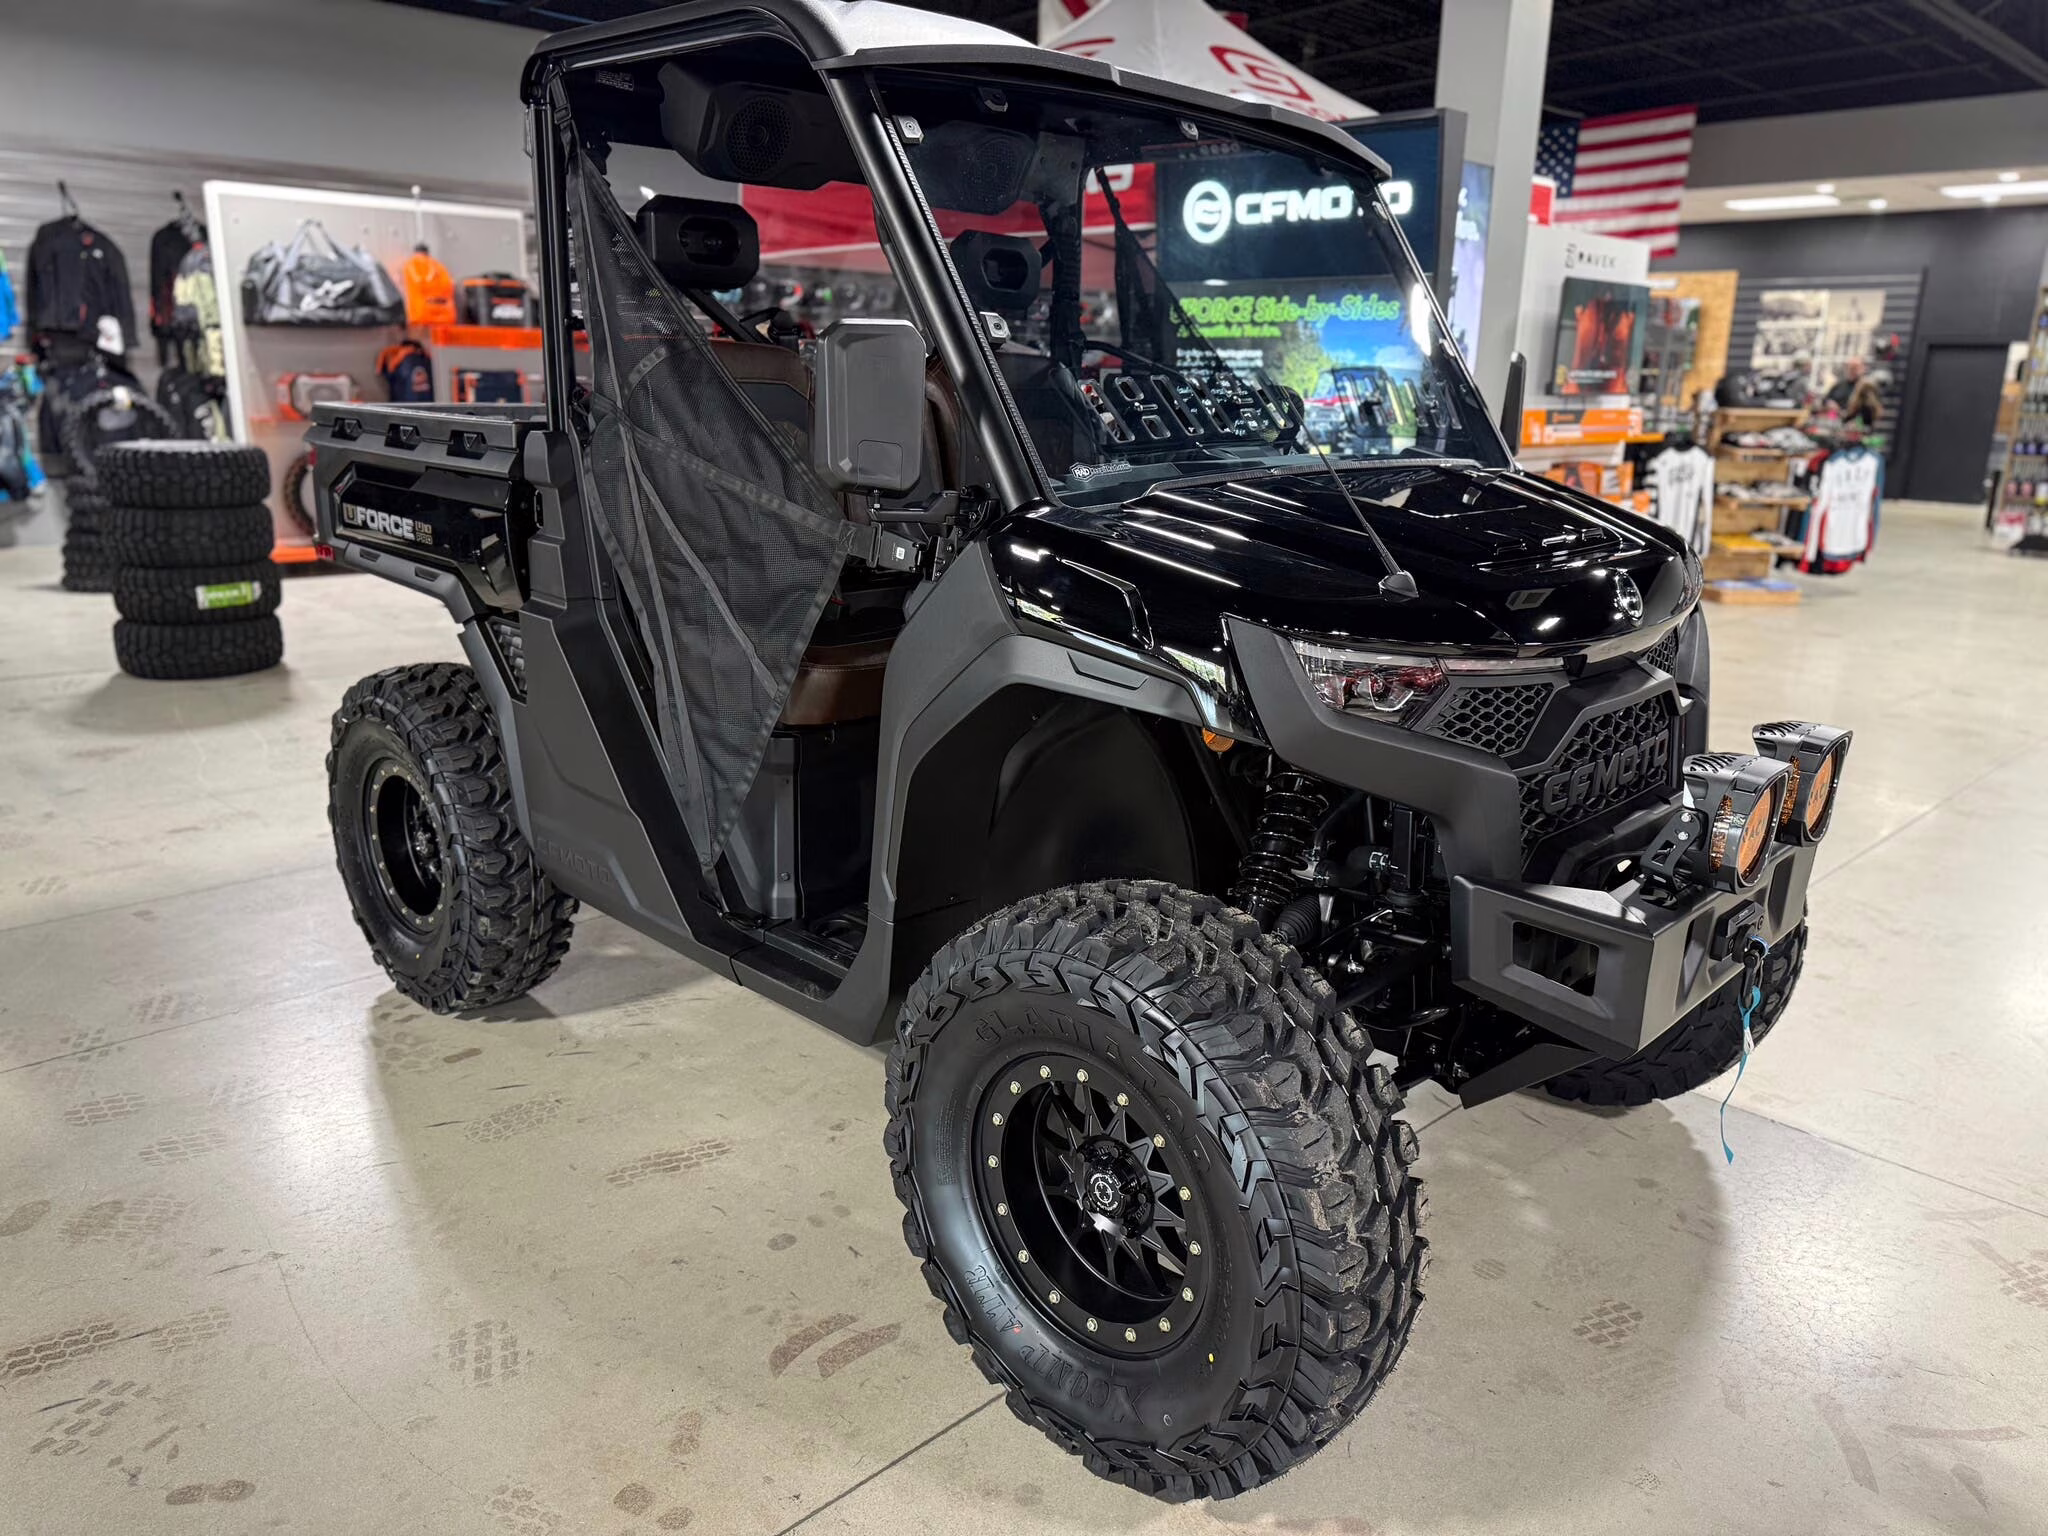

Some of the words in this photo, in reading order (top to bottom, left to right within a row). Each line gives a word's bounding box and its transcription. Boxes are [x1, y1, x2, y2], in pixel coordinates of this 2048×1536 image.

[1235, 178, 1413, 226] CFMOO
[1253, 293, 1400, 327] Side-by-Sides
[1543, 729, 1669, 814] CFMOTO
